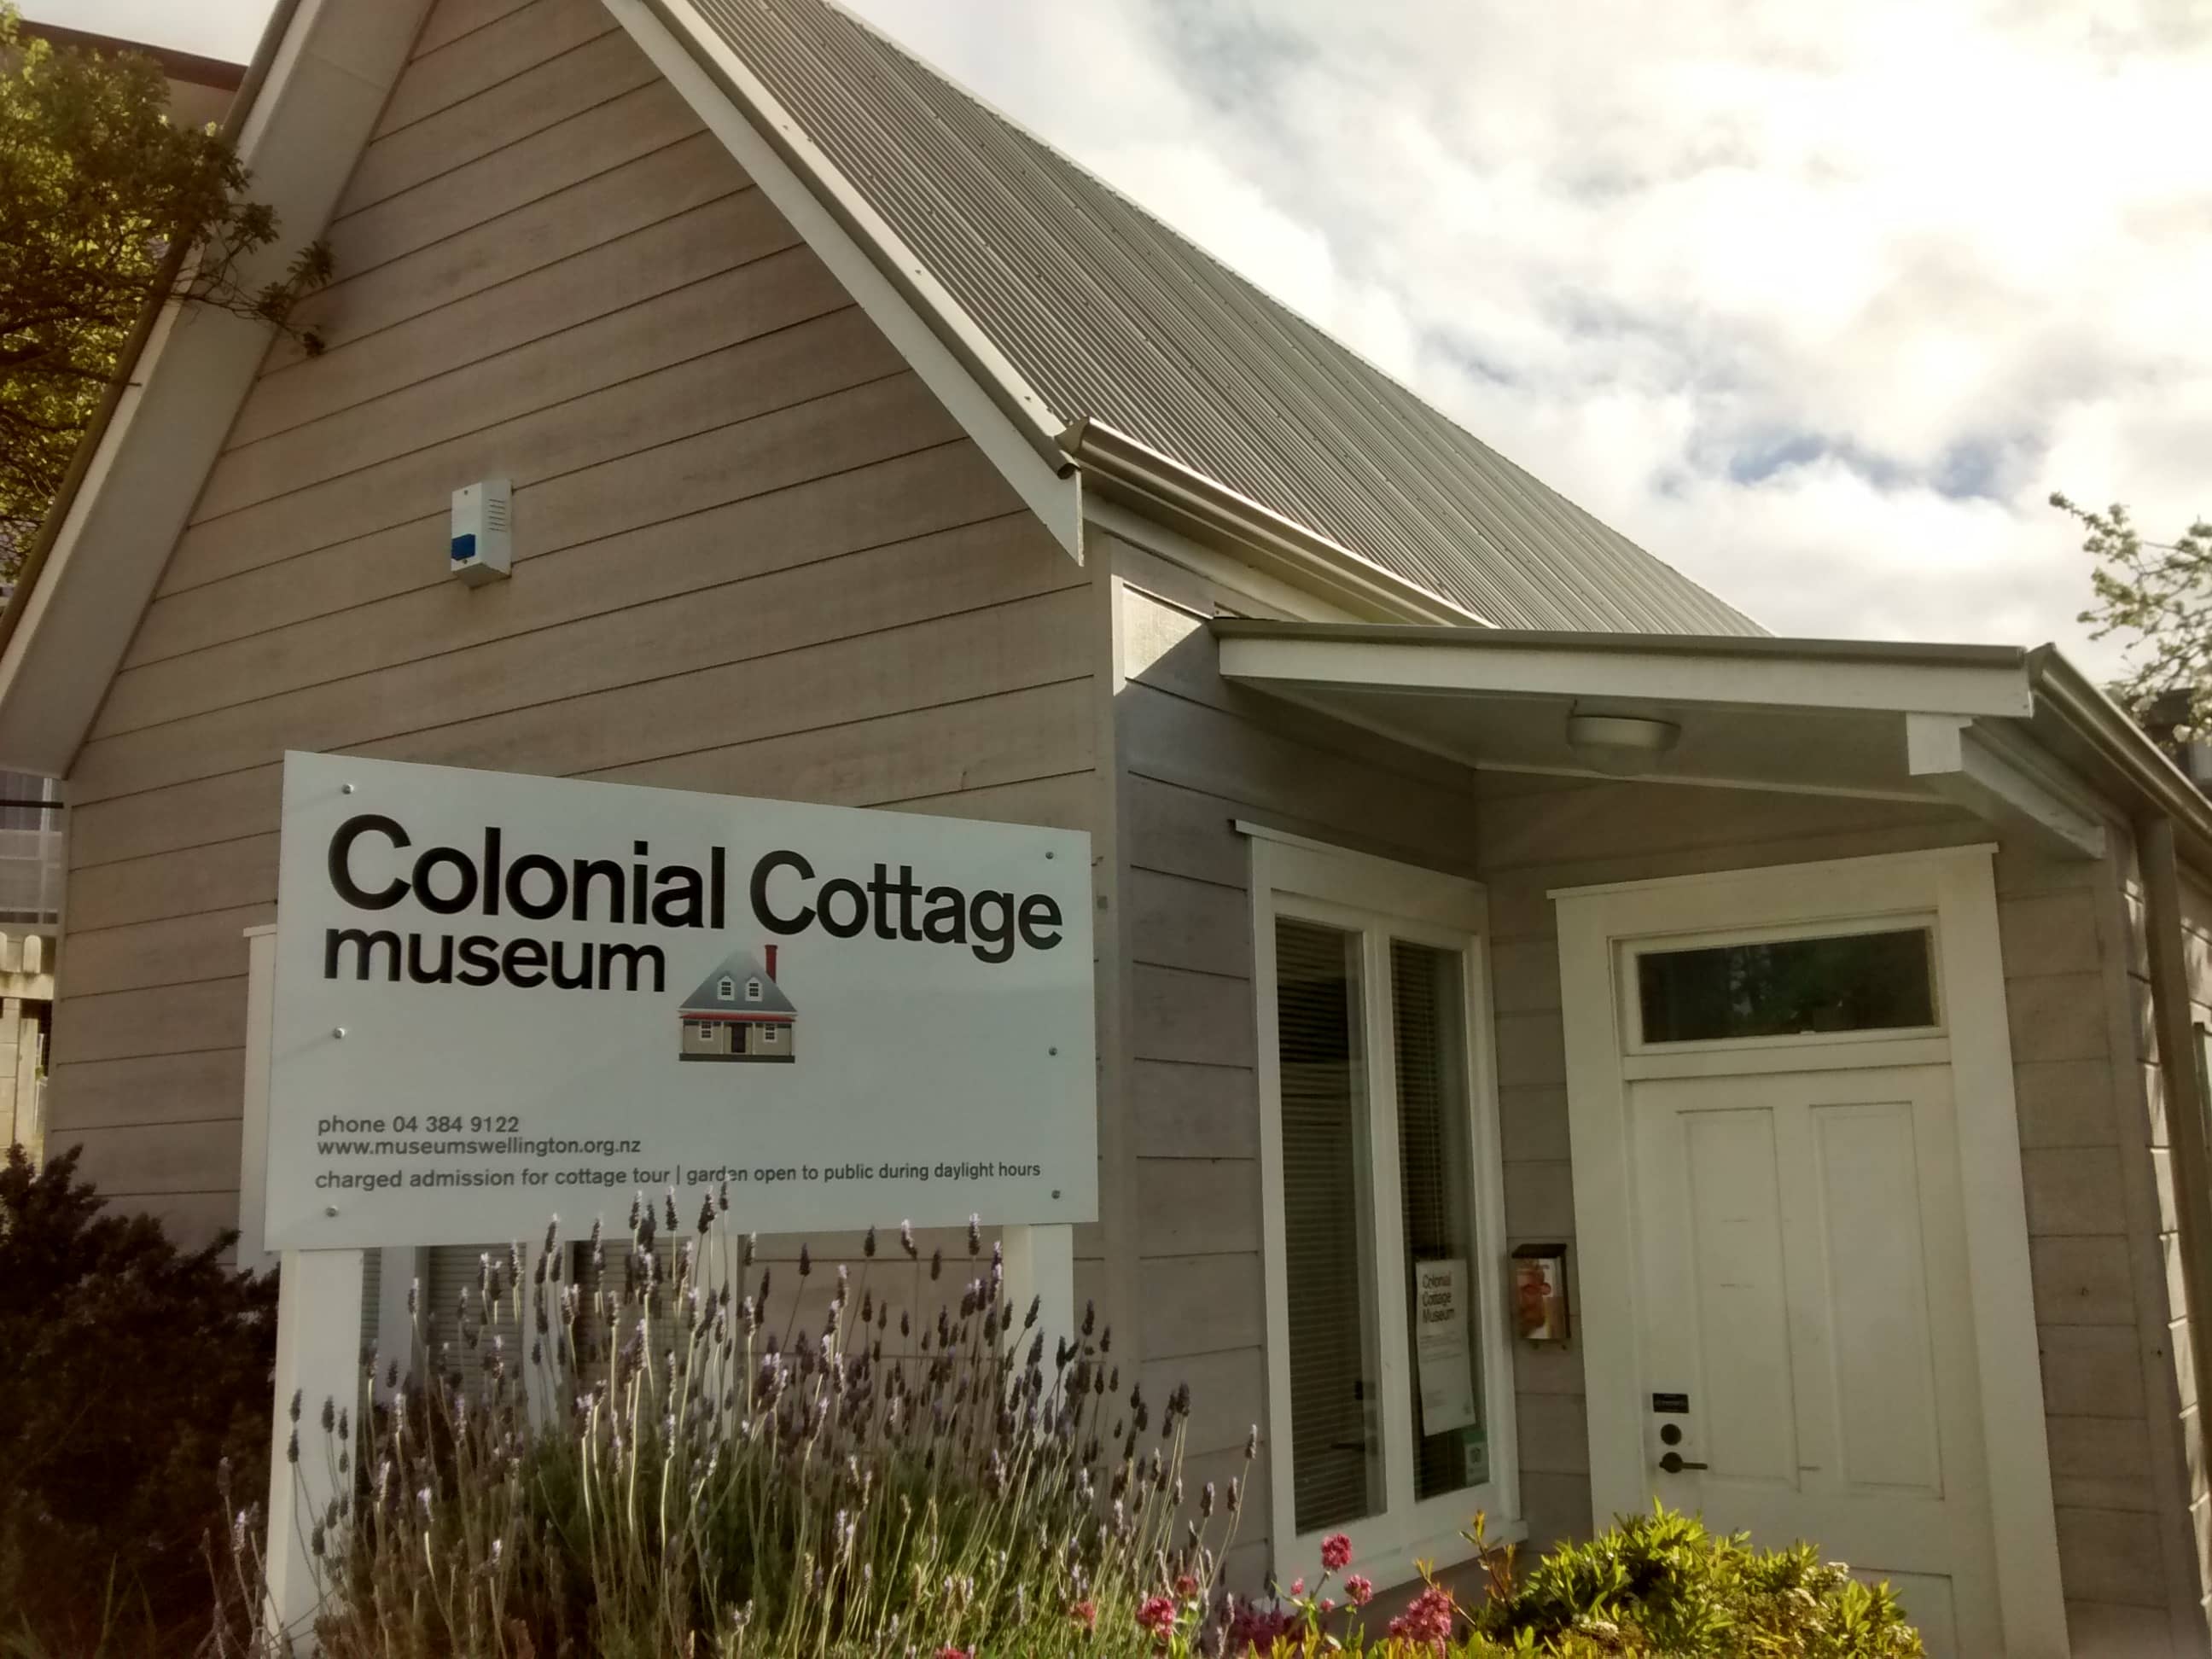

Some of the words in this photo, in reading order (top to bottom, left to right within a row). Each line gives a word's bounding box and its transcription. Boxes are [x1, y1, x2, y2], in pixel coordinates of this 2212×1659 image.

[327, 813, 725, 929] Colonial
[749, 849, 1063, 964] Cottage
[324, 927, 666, 992] museum
[317, 1115, 386, 1136] phone
[393, 1115, 418, 1133] 04
[426, 1115, 463, 1133] 384
[470, 1115, 520, 1133] 9122
[317, 1137, 641, 1157] www.museumswellington.org.nz
[315, 1169, 403, 1192] charged
[409, 1168, 515, 1188] admission
[521, 1167, 549, 1185] for
[555, 1168, 627, 1187] cottage
[633, 1167, 671, 1184] tour
[686, 1165, 748, 1185] garden
[754, 1168, 796, 1185] open
[802, 1166, 818, 1180] to
[824, 1163, 874, 1183] public
[878, 1163, 929, 1182] during
[934, 1161, 994, 1181] daylight
[998, 1161, 1041, 1177] hours
